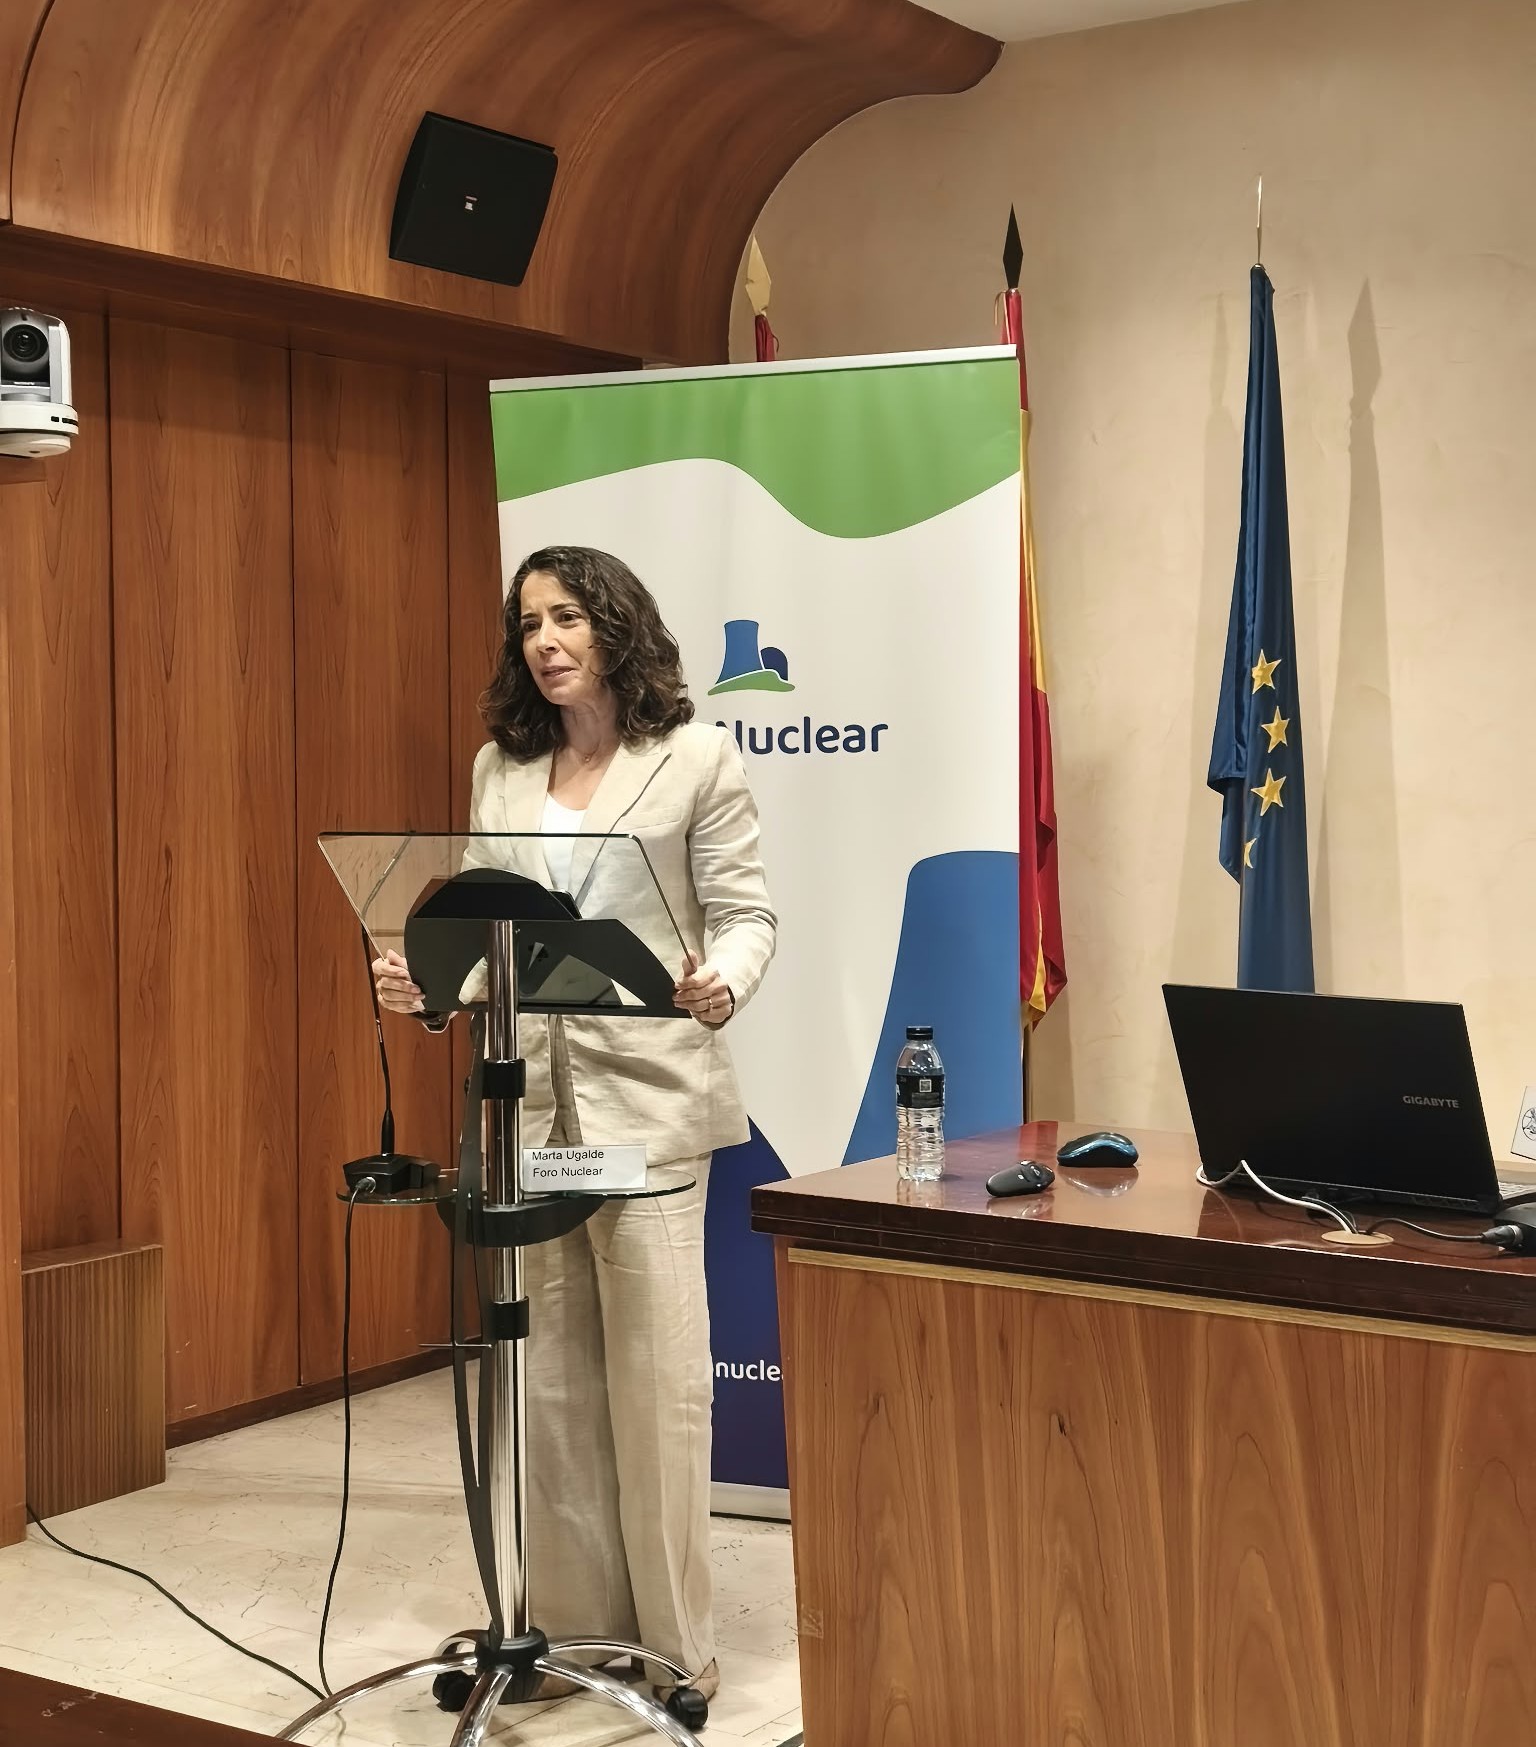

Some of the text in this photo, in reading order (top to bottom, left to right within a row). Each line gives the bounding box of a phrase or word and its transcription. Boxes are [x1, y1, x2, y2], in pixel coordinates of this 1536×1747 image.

[1402, 1095, 1460, 1109] GIGABYTE
[532, 1150, 604, 1161] Marta Ugalde
[533, 1166, 603, 1178] Foro Nuclear
[715, 1359, 783, 1382] nucle
